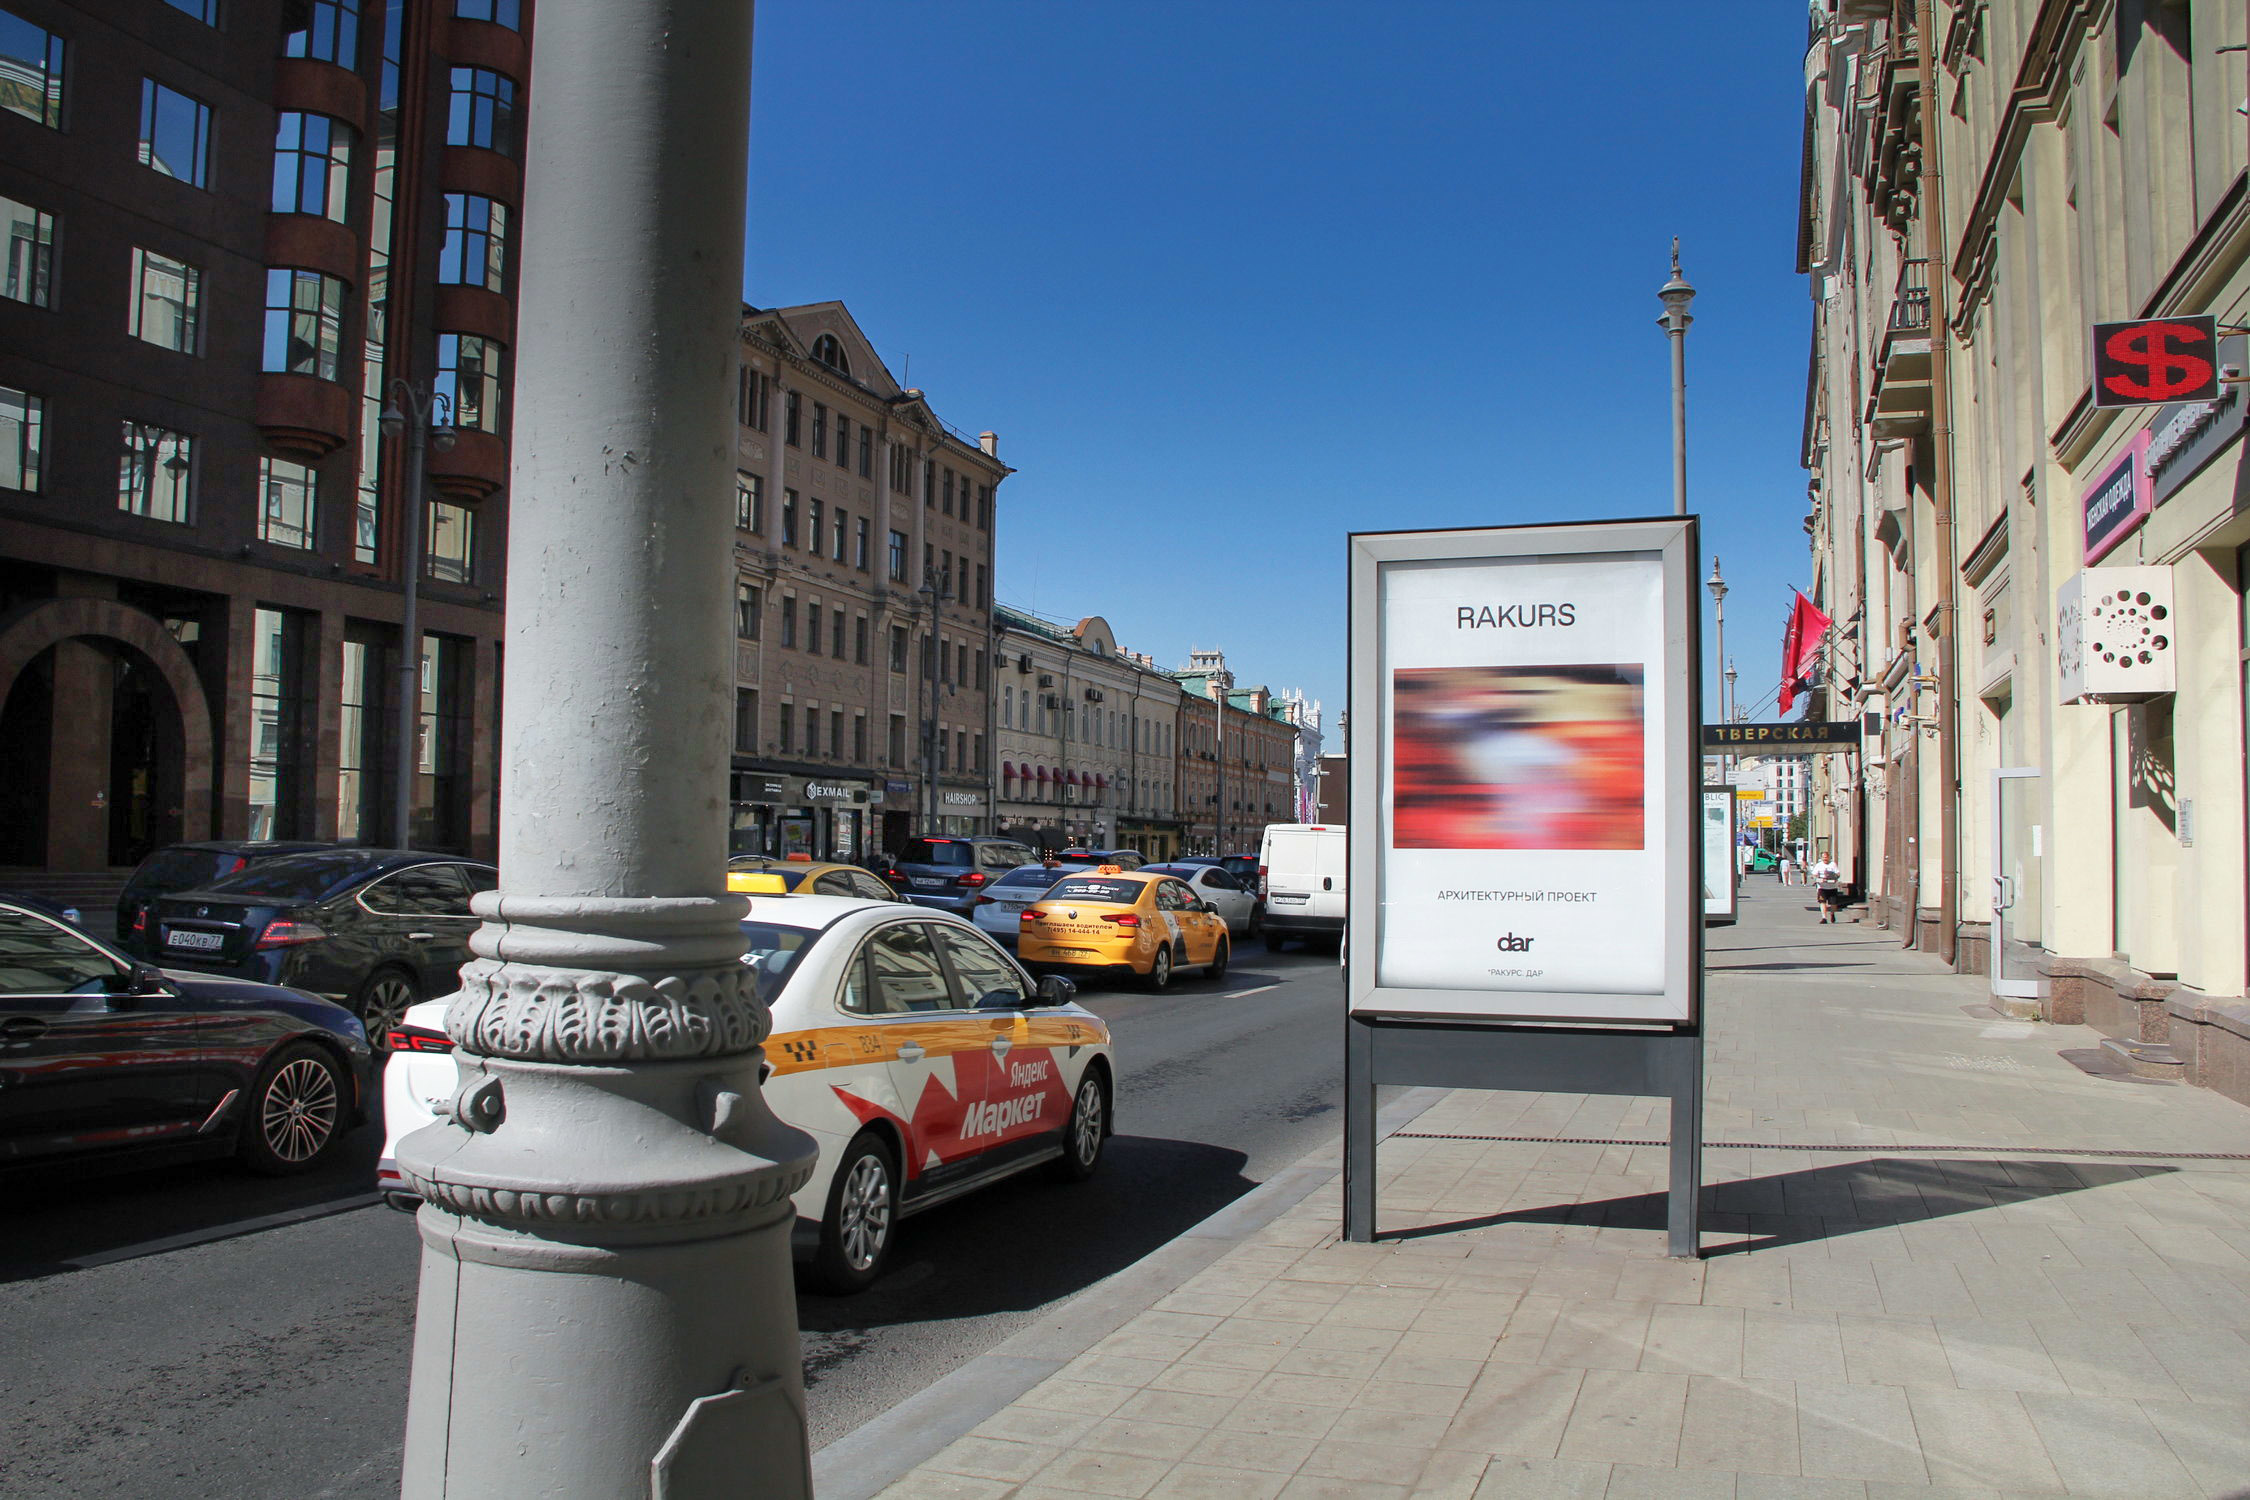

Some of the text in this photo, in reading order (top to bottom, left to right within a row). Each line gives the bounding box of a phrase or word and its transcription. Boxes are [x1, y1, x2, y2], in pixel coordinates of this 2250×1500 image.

[2109, 470, 2131, 512] ОДЕЖДА
[1457, 602, 1576, 630] RAKURS
[1715, 727, 1829, 741] ТВЕРСКАЯ
[816, 786, 850, 798] EXMAIL
[945, 792, 976, 805] HAIRSHOP
[1705, 793, 1724, 801] BLIC
[1437, 890, 1597, 902] АРХИТЕКТУРНЫЙ ПРОЕКТ
[1076, 922, 1113, 930] водителей
[1497, 932, 1534, 952] dar
[859, 1035, 881, 1053] 834
[1010, 1060, 1049, 1088] Яндекс
[960, 1092, 1046, 1140] Маркет
